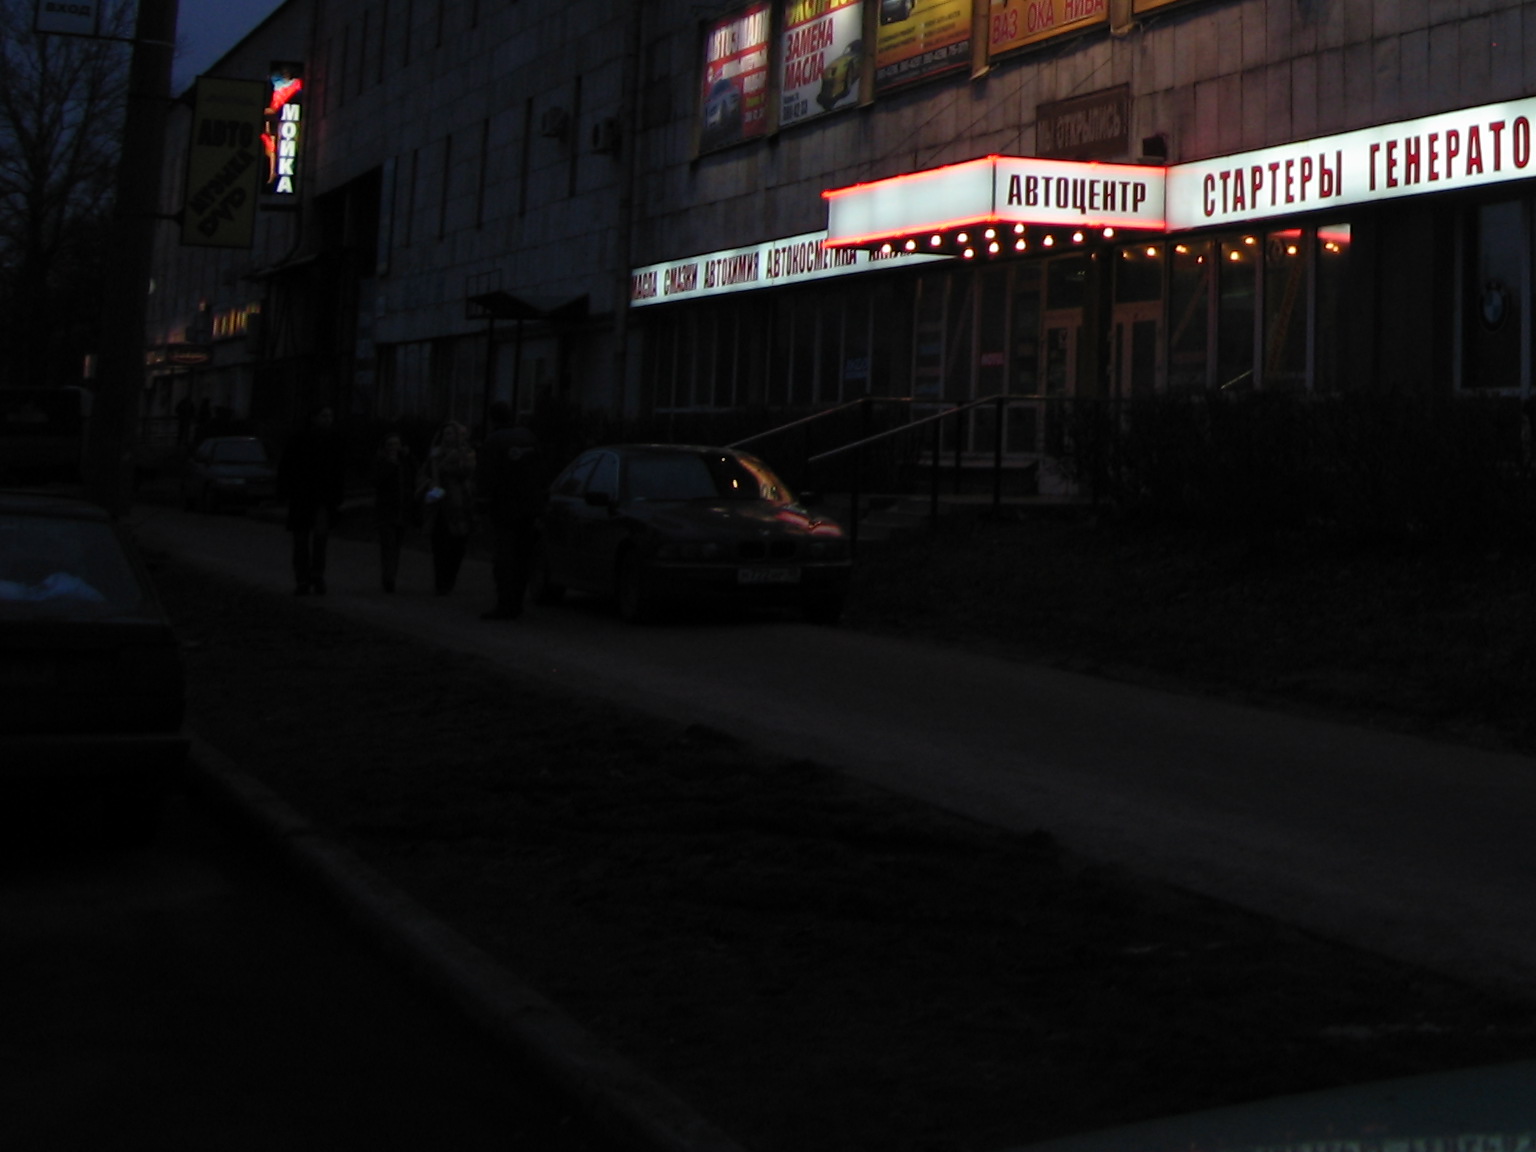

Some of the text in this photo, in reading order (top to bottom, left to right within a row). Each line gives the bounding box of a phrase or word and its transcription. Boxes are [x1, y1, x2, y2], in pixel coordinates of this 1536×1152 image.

[46, 2, 90, 17] ВХОД
[992, 8, 1017, 44] ВАЗ
[1027, 1, 1054, 32] ОКА
[786, 18, 833, 63] ЗАМЕНА
[784, 51, 824, 91] МАСЛА
[1007, 174, 1147, 214] АВТОЦЕНТР
[1203, 150, 1343, 217] СТАРТЕРЫ
[664, 263, 698, 296] СМАЗКИ
[704, 251, 759, 289] АВТОХИМИЯ
